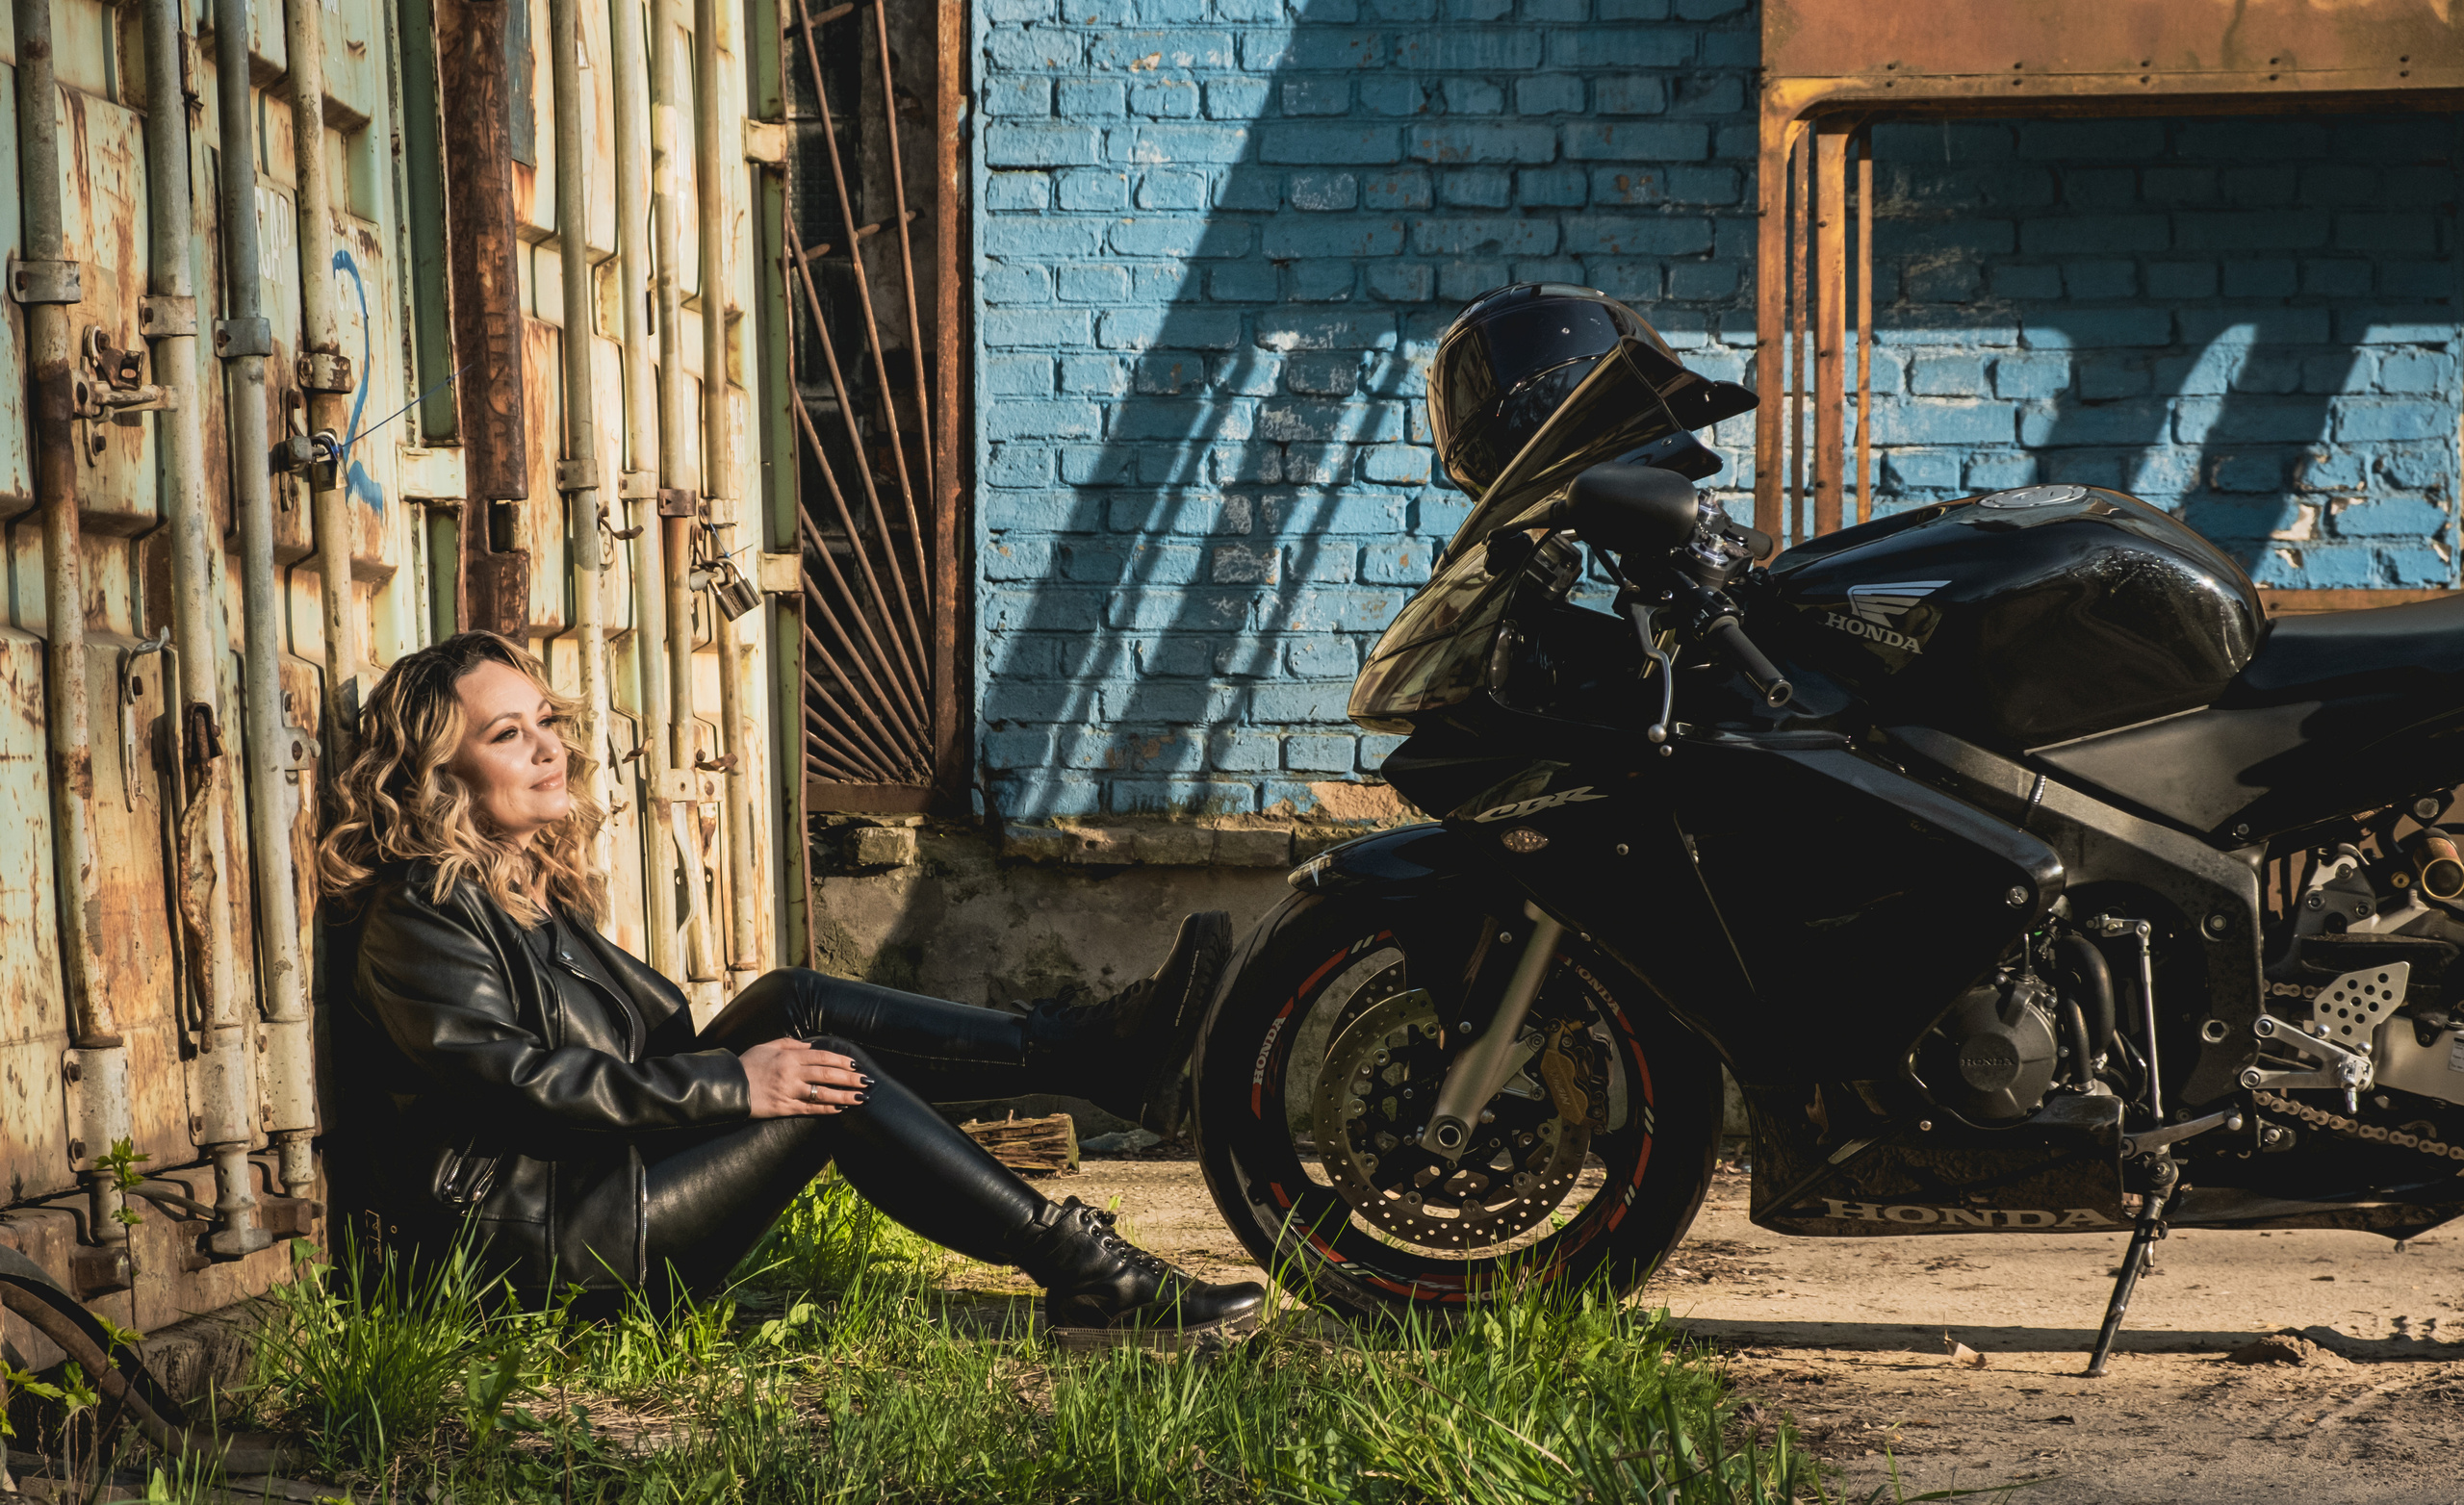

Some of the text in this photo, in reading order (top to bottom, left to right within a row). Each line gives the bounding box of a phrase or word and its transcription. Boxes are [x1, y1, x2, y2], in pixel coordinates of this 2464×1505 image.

[254, 186, 290, 286] CAP
[1824, 611, 1924, 655] HONDA
[1474, 785, 1609, 824] CBR
[1252, 1016, 1287, 1085] HONDA
[1960, 1057, 2016, 1067] HONDA
[1821, 1197, 2119, 1229] HONDA
